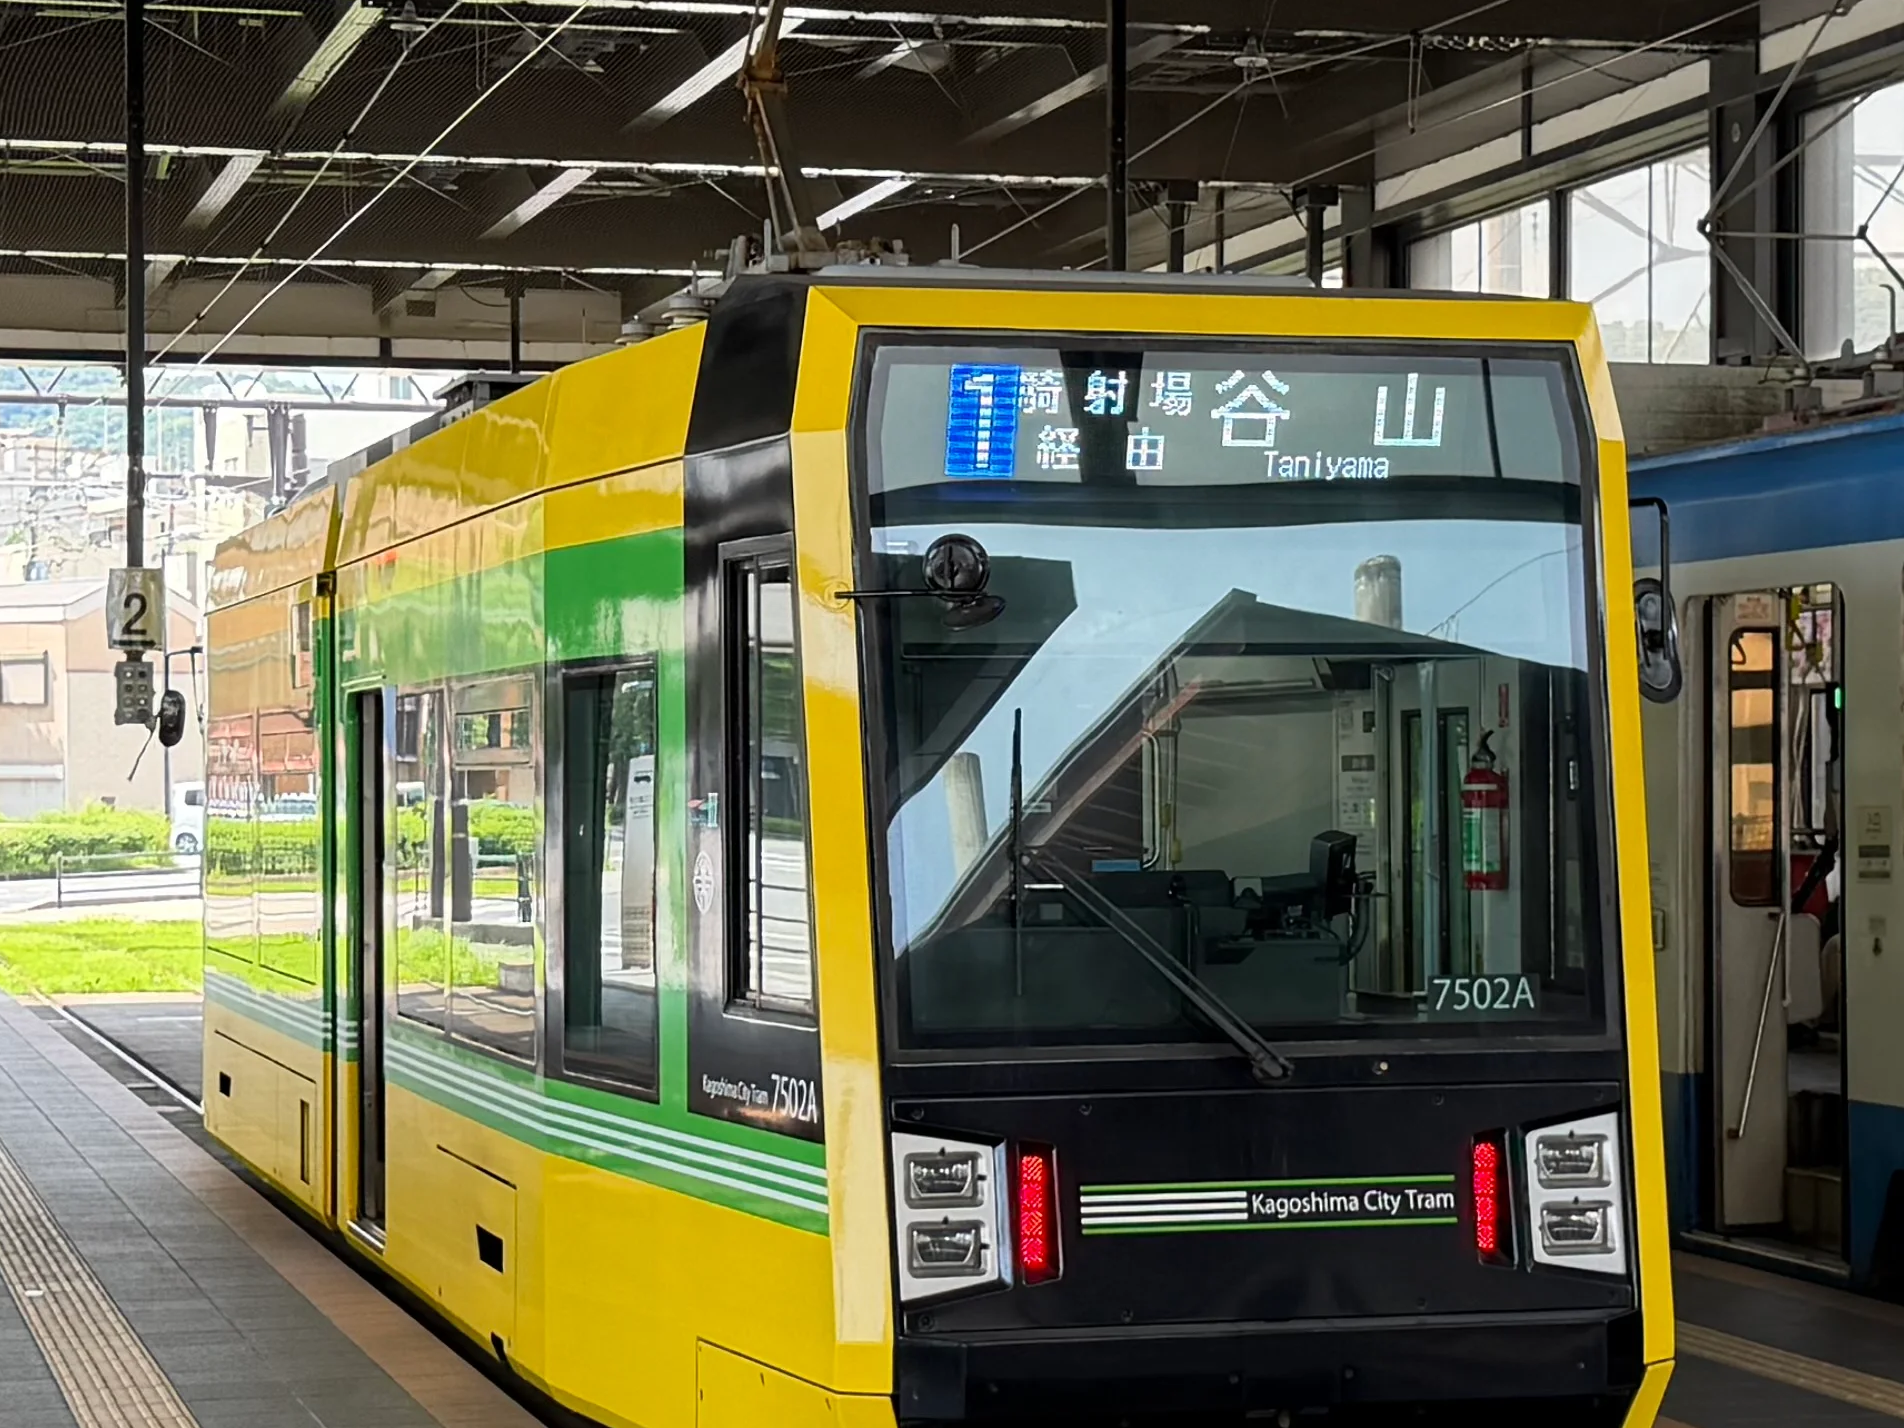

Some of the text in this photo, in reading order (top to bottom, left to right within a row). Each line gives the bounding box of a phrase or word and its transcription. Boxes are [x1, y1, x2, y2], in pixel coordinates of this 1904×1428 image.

[1018, 369, 1193, 417] 騎射場
[1210, 369, 1446, 447] 谷山
[963, 373, 995, 469] 1
[1036, 425, 1165, 470] 経由
[1263, 451, 1390, 481] Taniyama
[121, 592, 148, 636] 2
[1432, 976, 1536, 1012] 7502A
[770, 1073, 817, 1124] 7502A
[1251, 1188, 1456, 1219] Kagoshima City Tram
